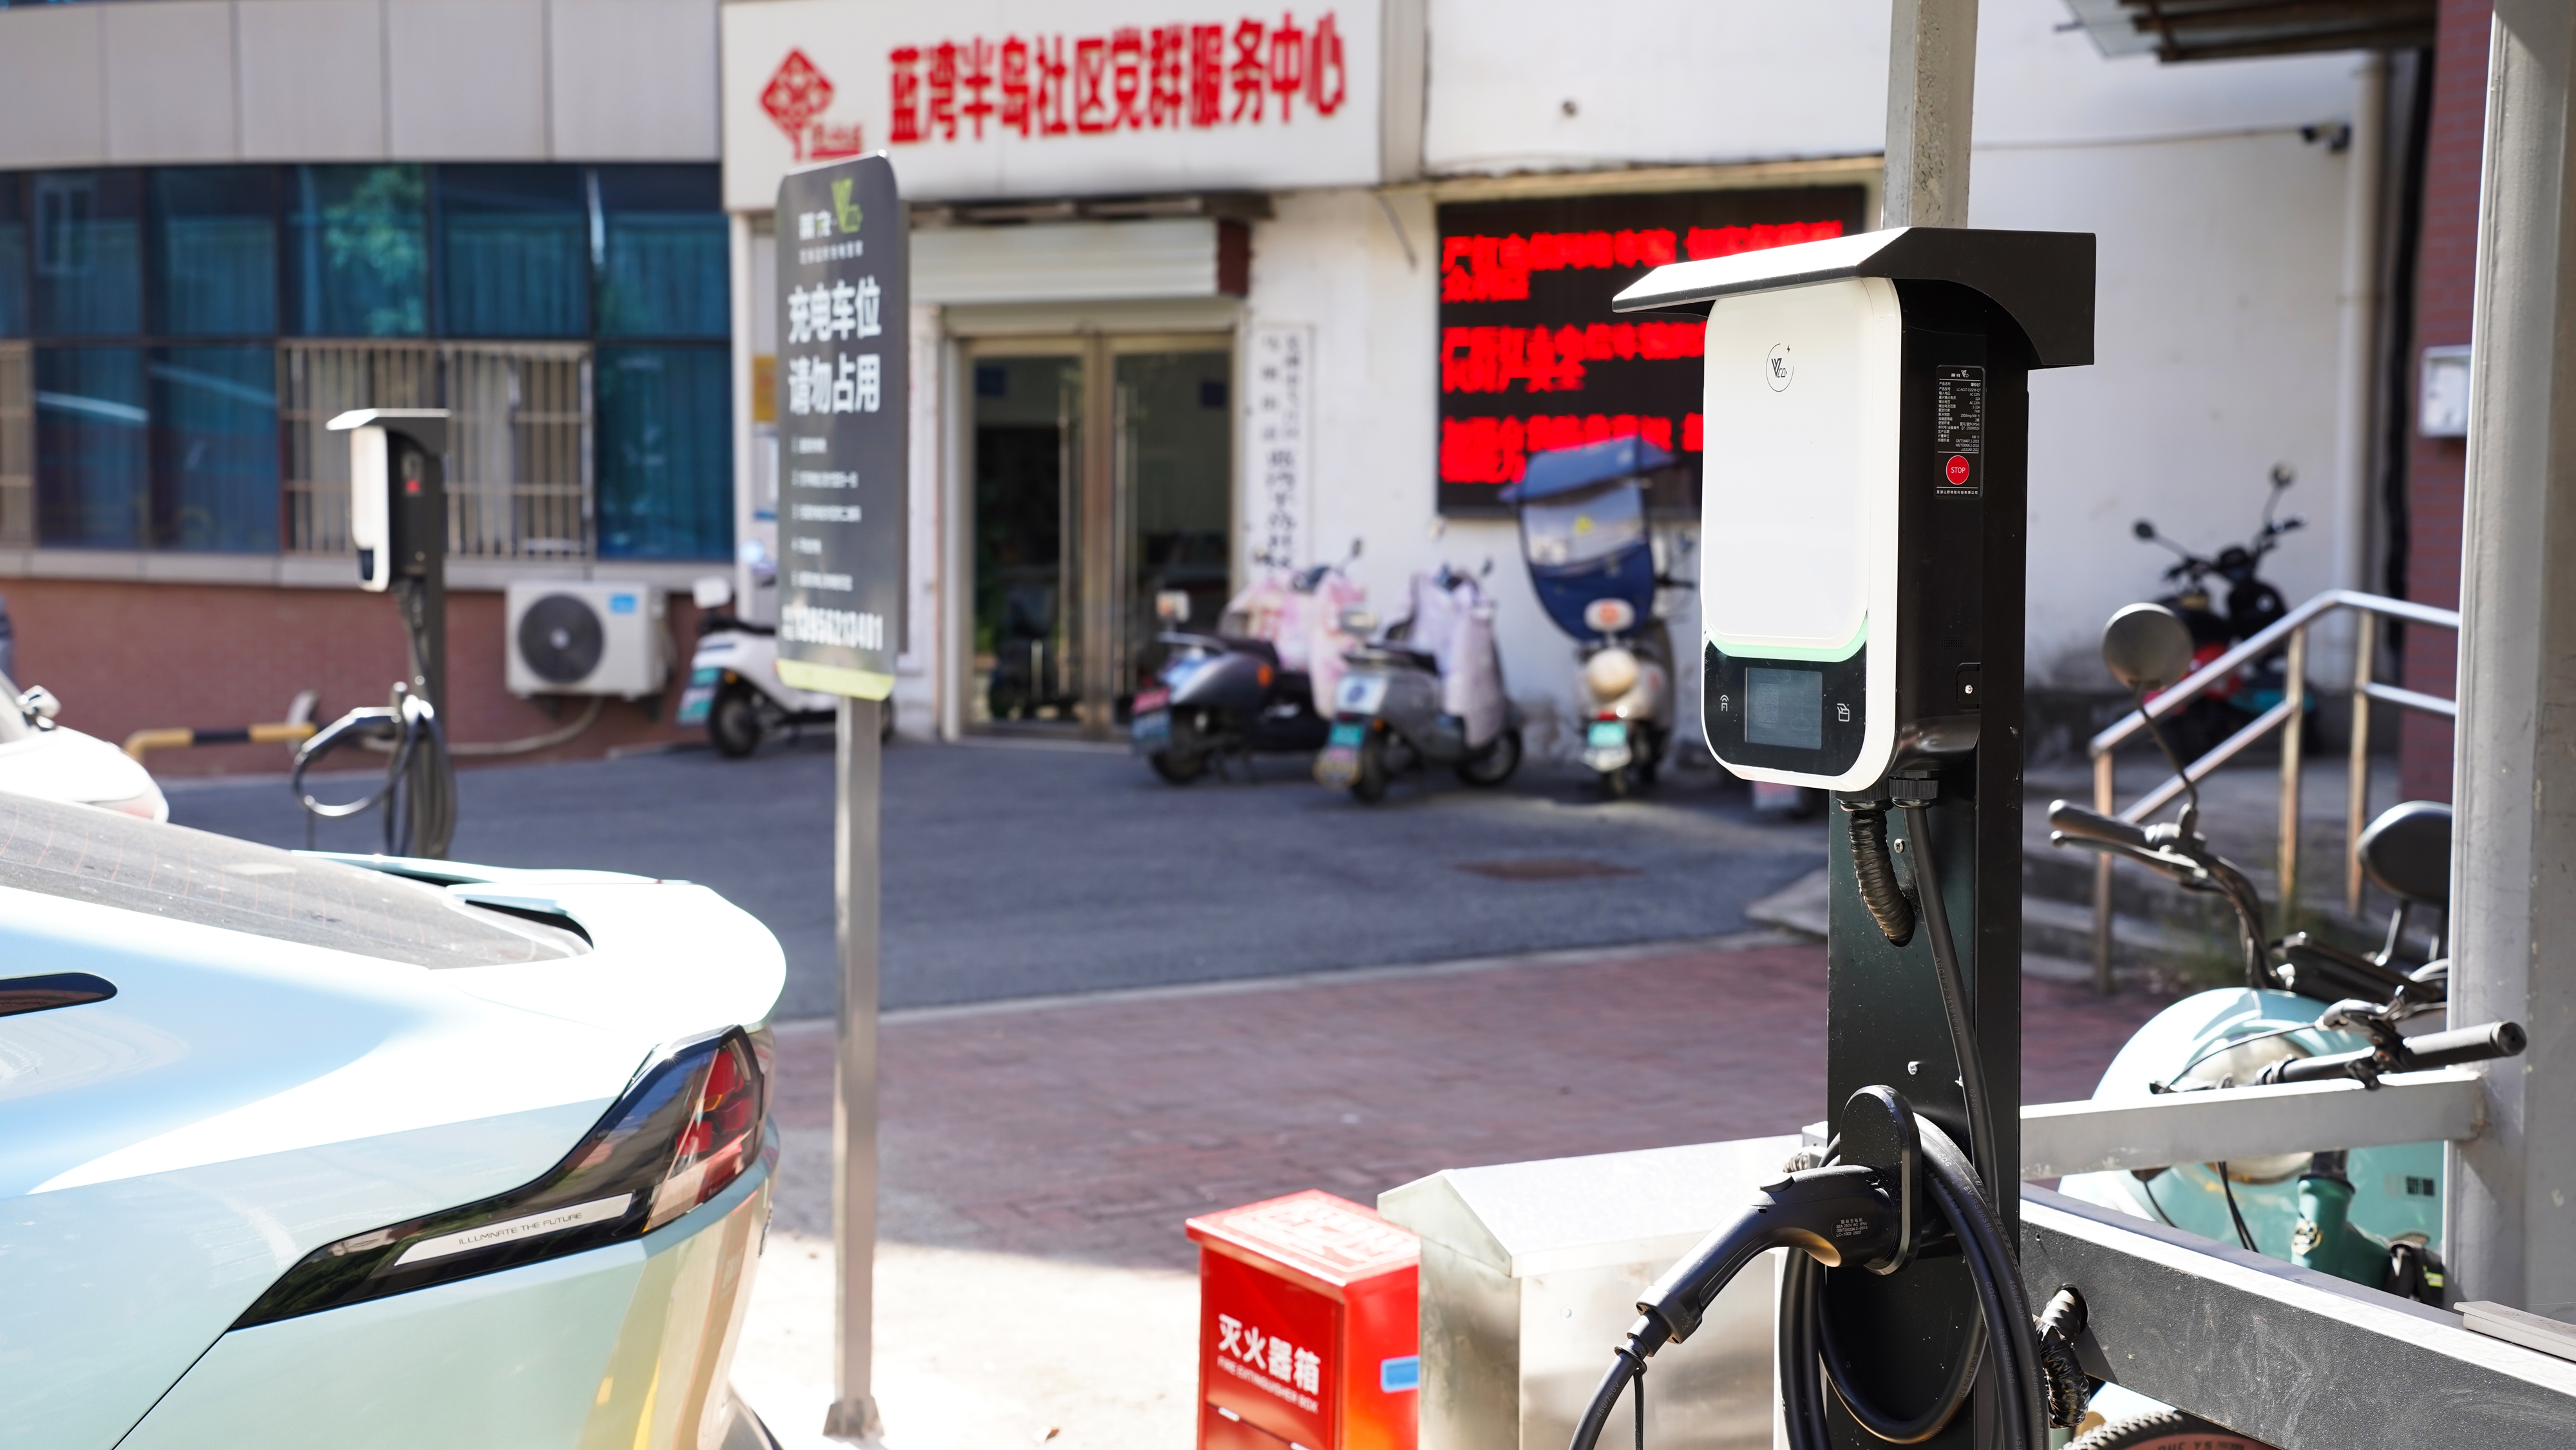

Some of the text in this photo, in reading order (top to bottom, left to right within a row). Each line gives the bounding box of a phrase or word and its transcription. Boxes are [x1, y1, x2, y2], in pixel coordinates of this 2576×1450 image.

[890, 11, 1346, 144] 蓝湾半岛社区党群服务中心
[788, 275, 882, 345] 充电车位
[788, 352, 881, 415] 请勿占用
[459, 1212, 583, 1245] ILLUMINATE THE FUTURE
[1937, 1152, 1952, 1167] CQC
[1963, 1185, 1994, 1232] EV-RS90S90
[2009, 1279, 2027, 1320] 450/750V
[1218, 1313, 1321, 1396] 灭火器箱
[1985, 1281, 1996, 1300] CQC
[1998, 1328, 2015, 1384] EV-RS90S90
